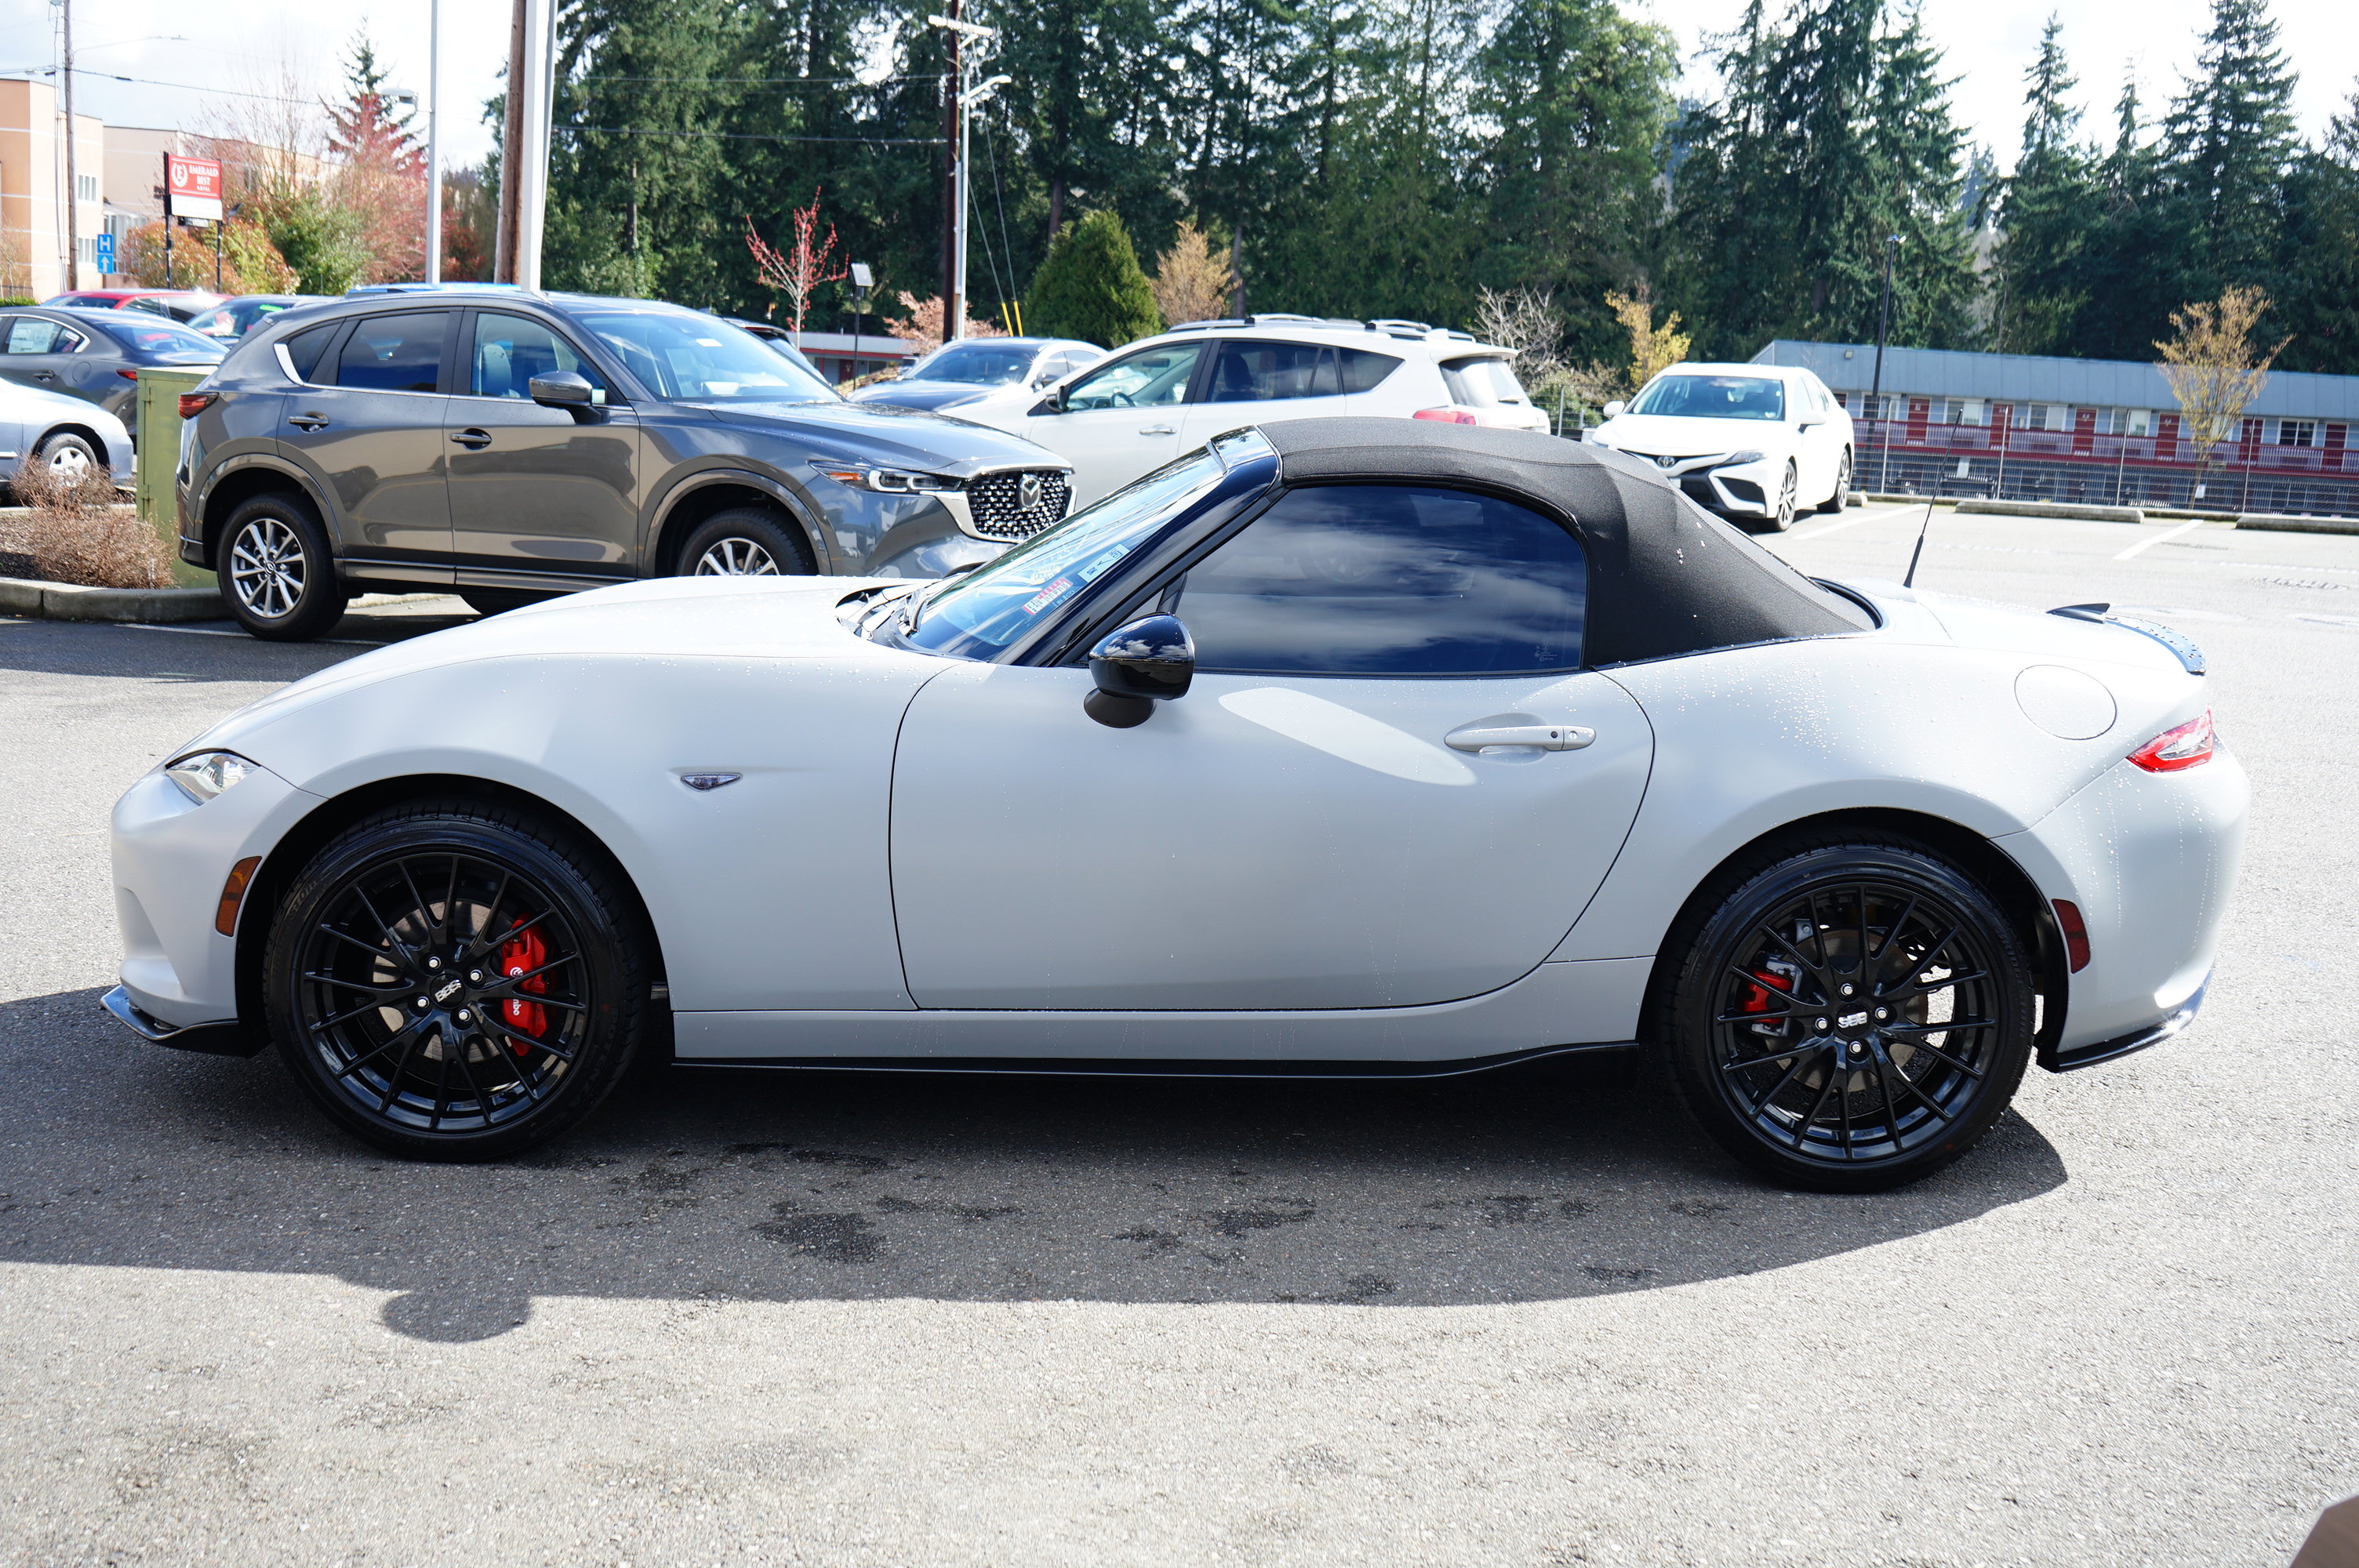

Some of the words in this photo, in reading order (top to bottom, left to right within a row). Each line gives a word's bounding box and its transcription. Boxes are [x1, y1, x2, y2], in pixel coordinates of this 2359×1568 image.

[100, 236, 111, 252] H
[434, 979, 462, 1003] BBS
[1837, 1011, 1868, 1029] BBS
